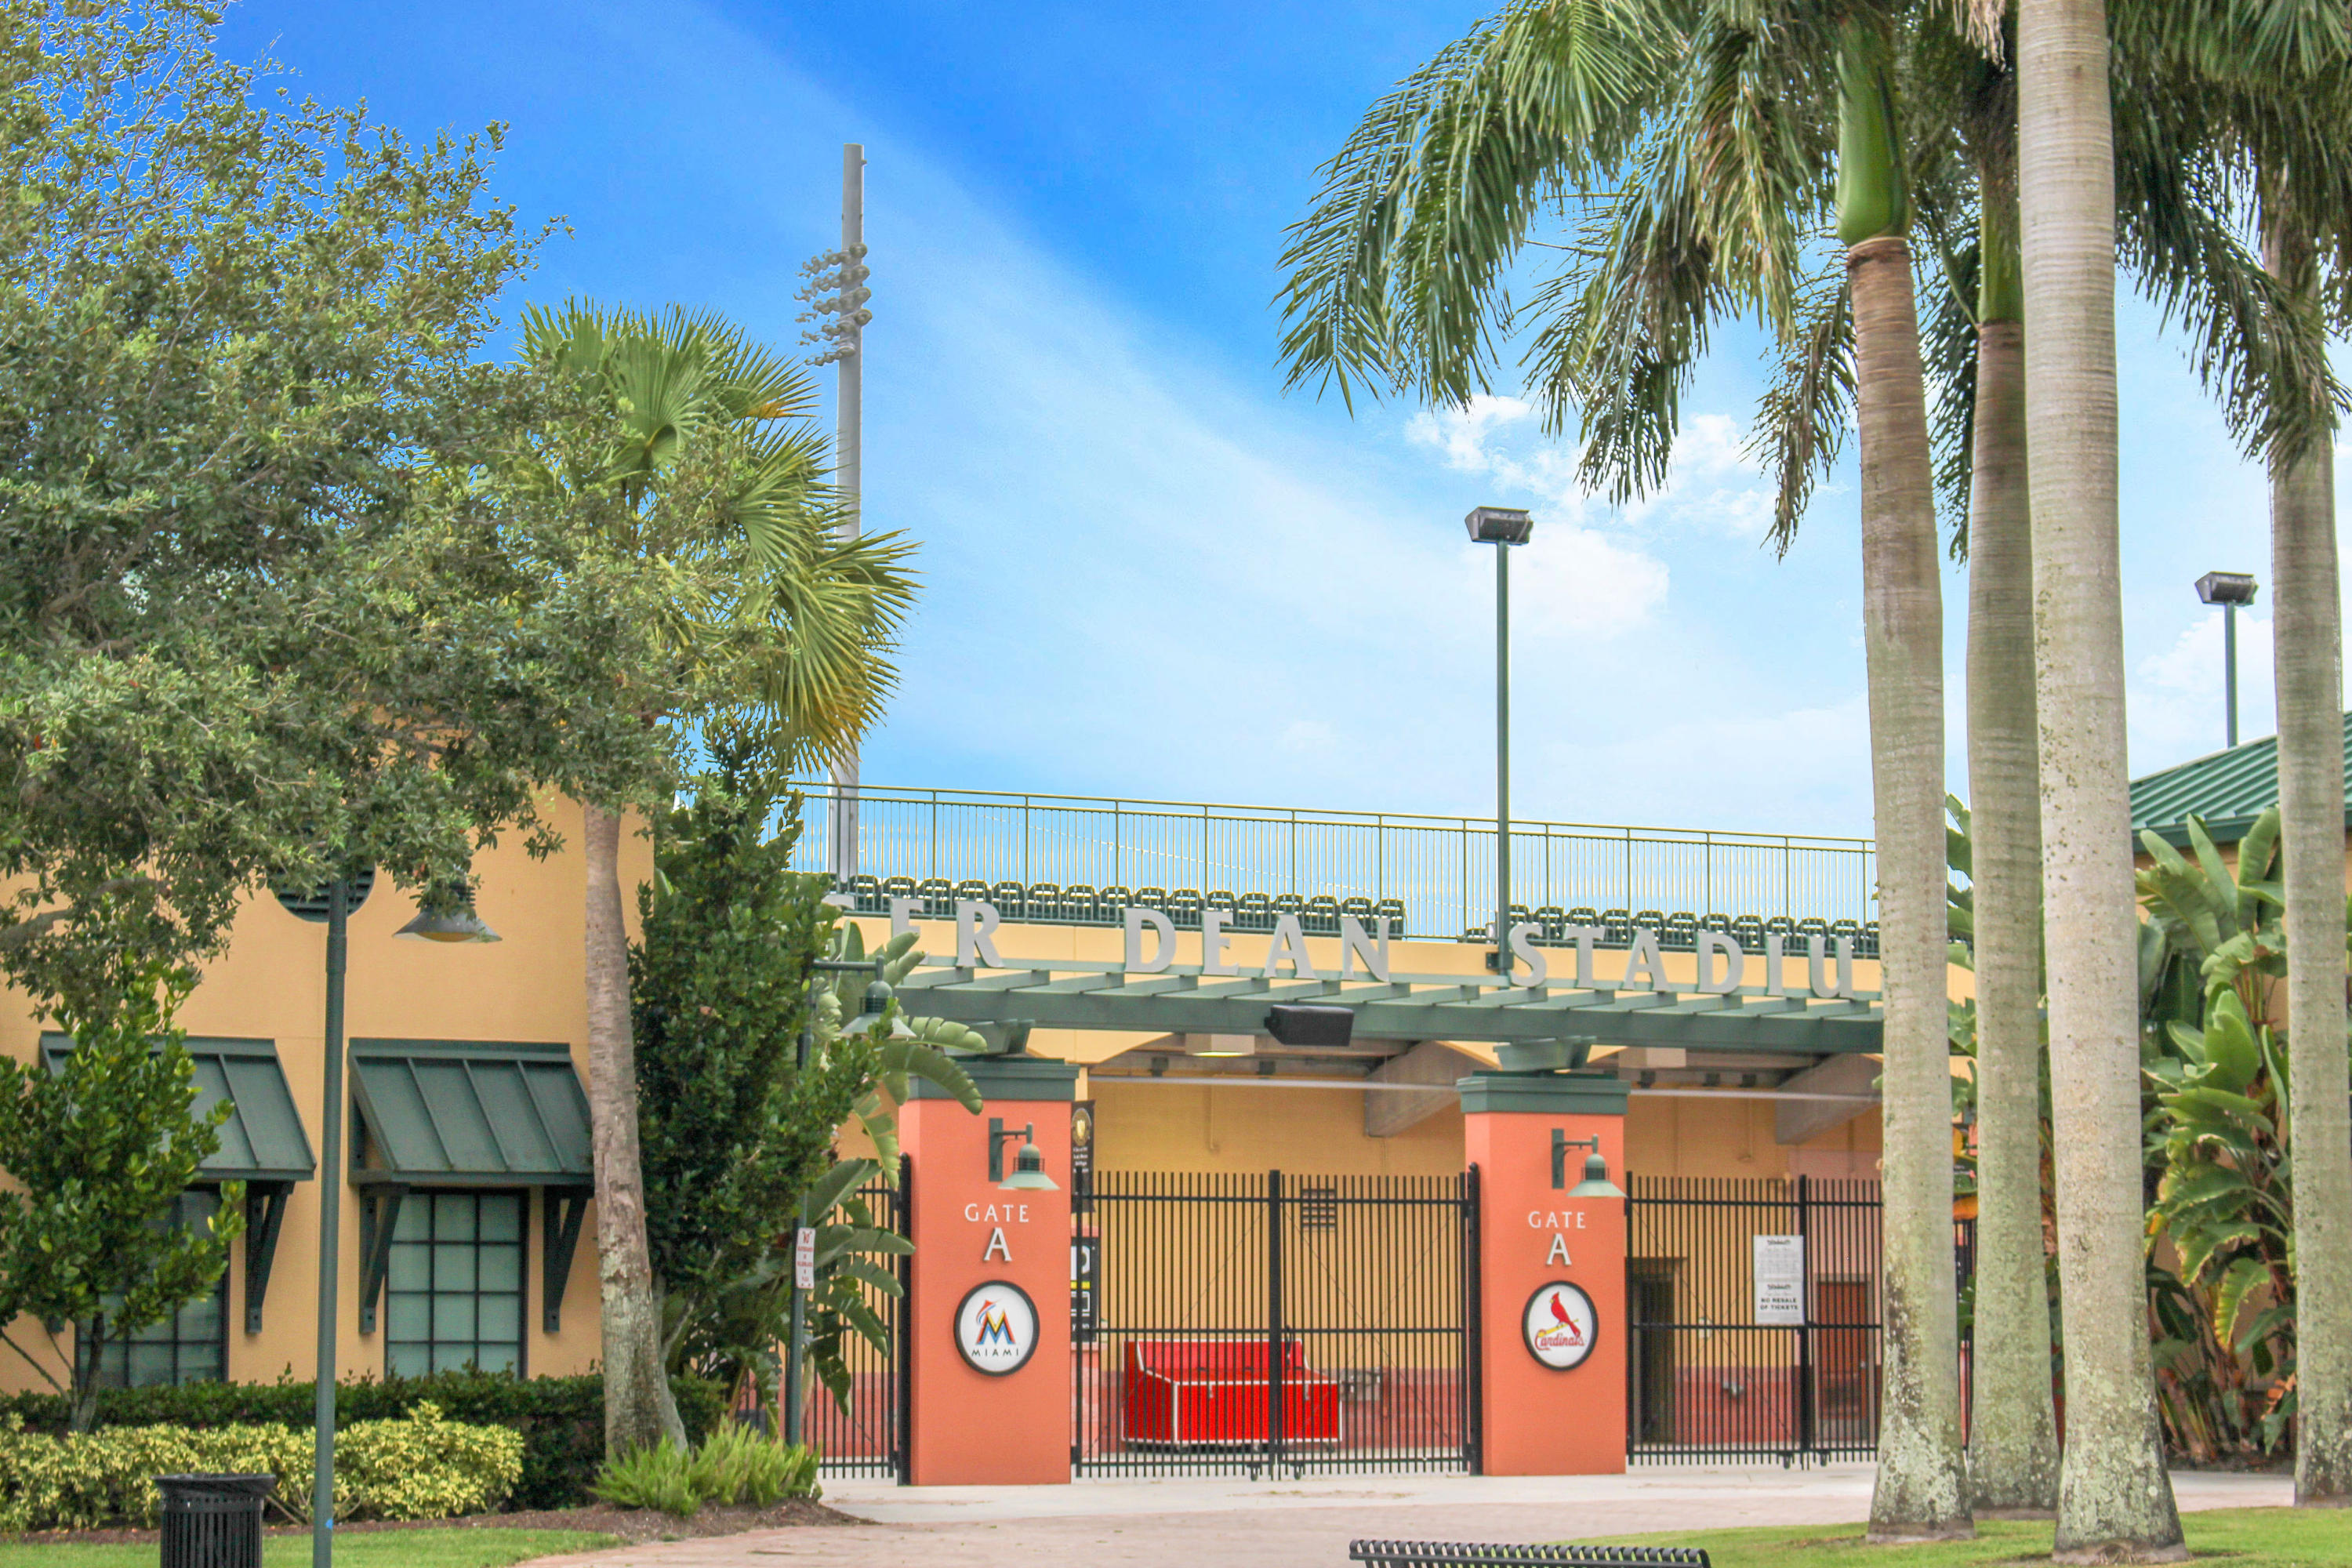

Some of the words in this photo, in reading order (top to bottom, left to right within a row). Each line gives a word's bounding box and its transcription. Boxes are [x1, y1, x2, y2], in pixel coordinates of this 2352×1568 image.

[822, 895, 1005, 968] ER
[1124, 907, 1391, 982] DEAN
[1508, 923, 1854, 999] STADIU
[964, 1203, 1029, 1222] GATE
[1529, 1210, 1586, 1229] GATE
[983, 1227, 1012, 1261] A
[1545, 1232, 1573, 1266] A
[1534, 1328, 1585, 1351] Cardinals
[971, 1348, 1019, 1357] MIAMI
